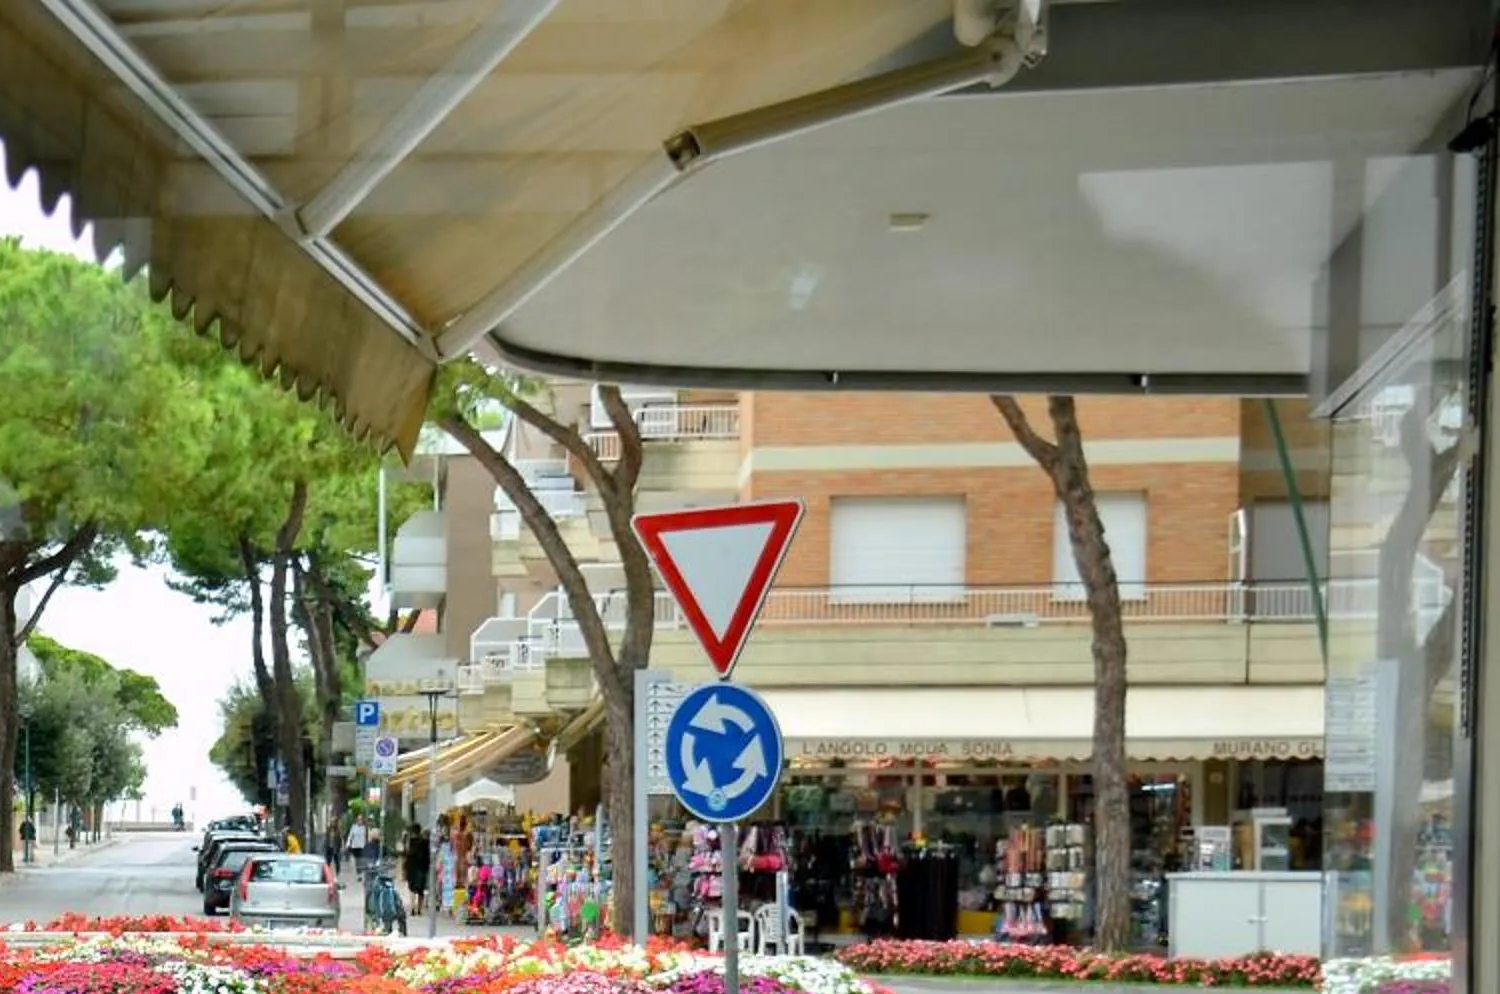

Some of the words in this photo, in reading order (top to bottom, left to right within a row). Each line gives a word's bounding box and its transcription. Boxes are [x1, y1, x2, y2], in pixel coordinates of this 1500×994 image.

[359, 703, 375, 724] P
[899, 741, 949, 756] MODA
[961, 741, 1014, 756] SONIA
[1212, 740, 1291, 755] MURANO
